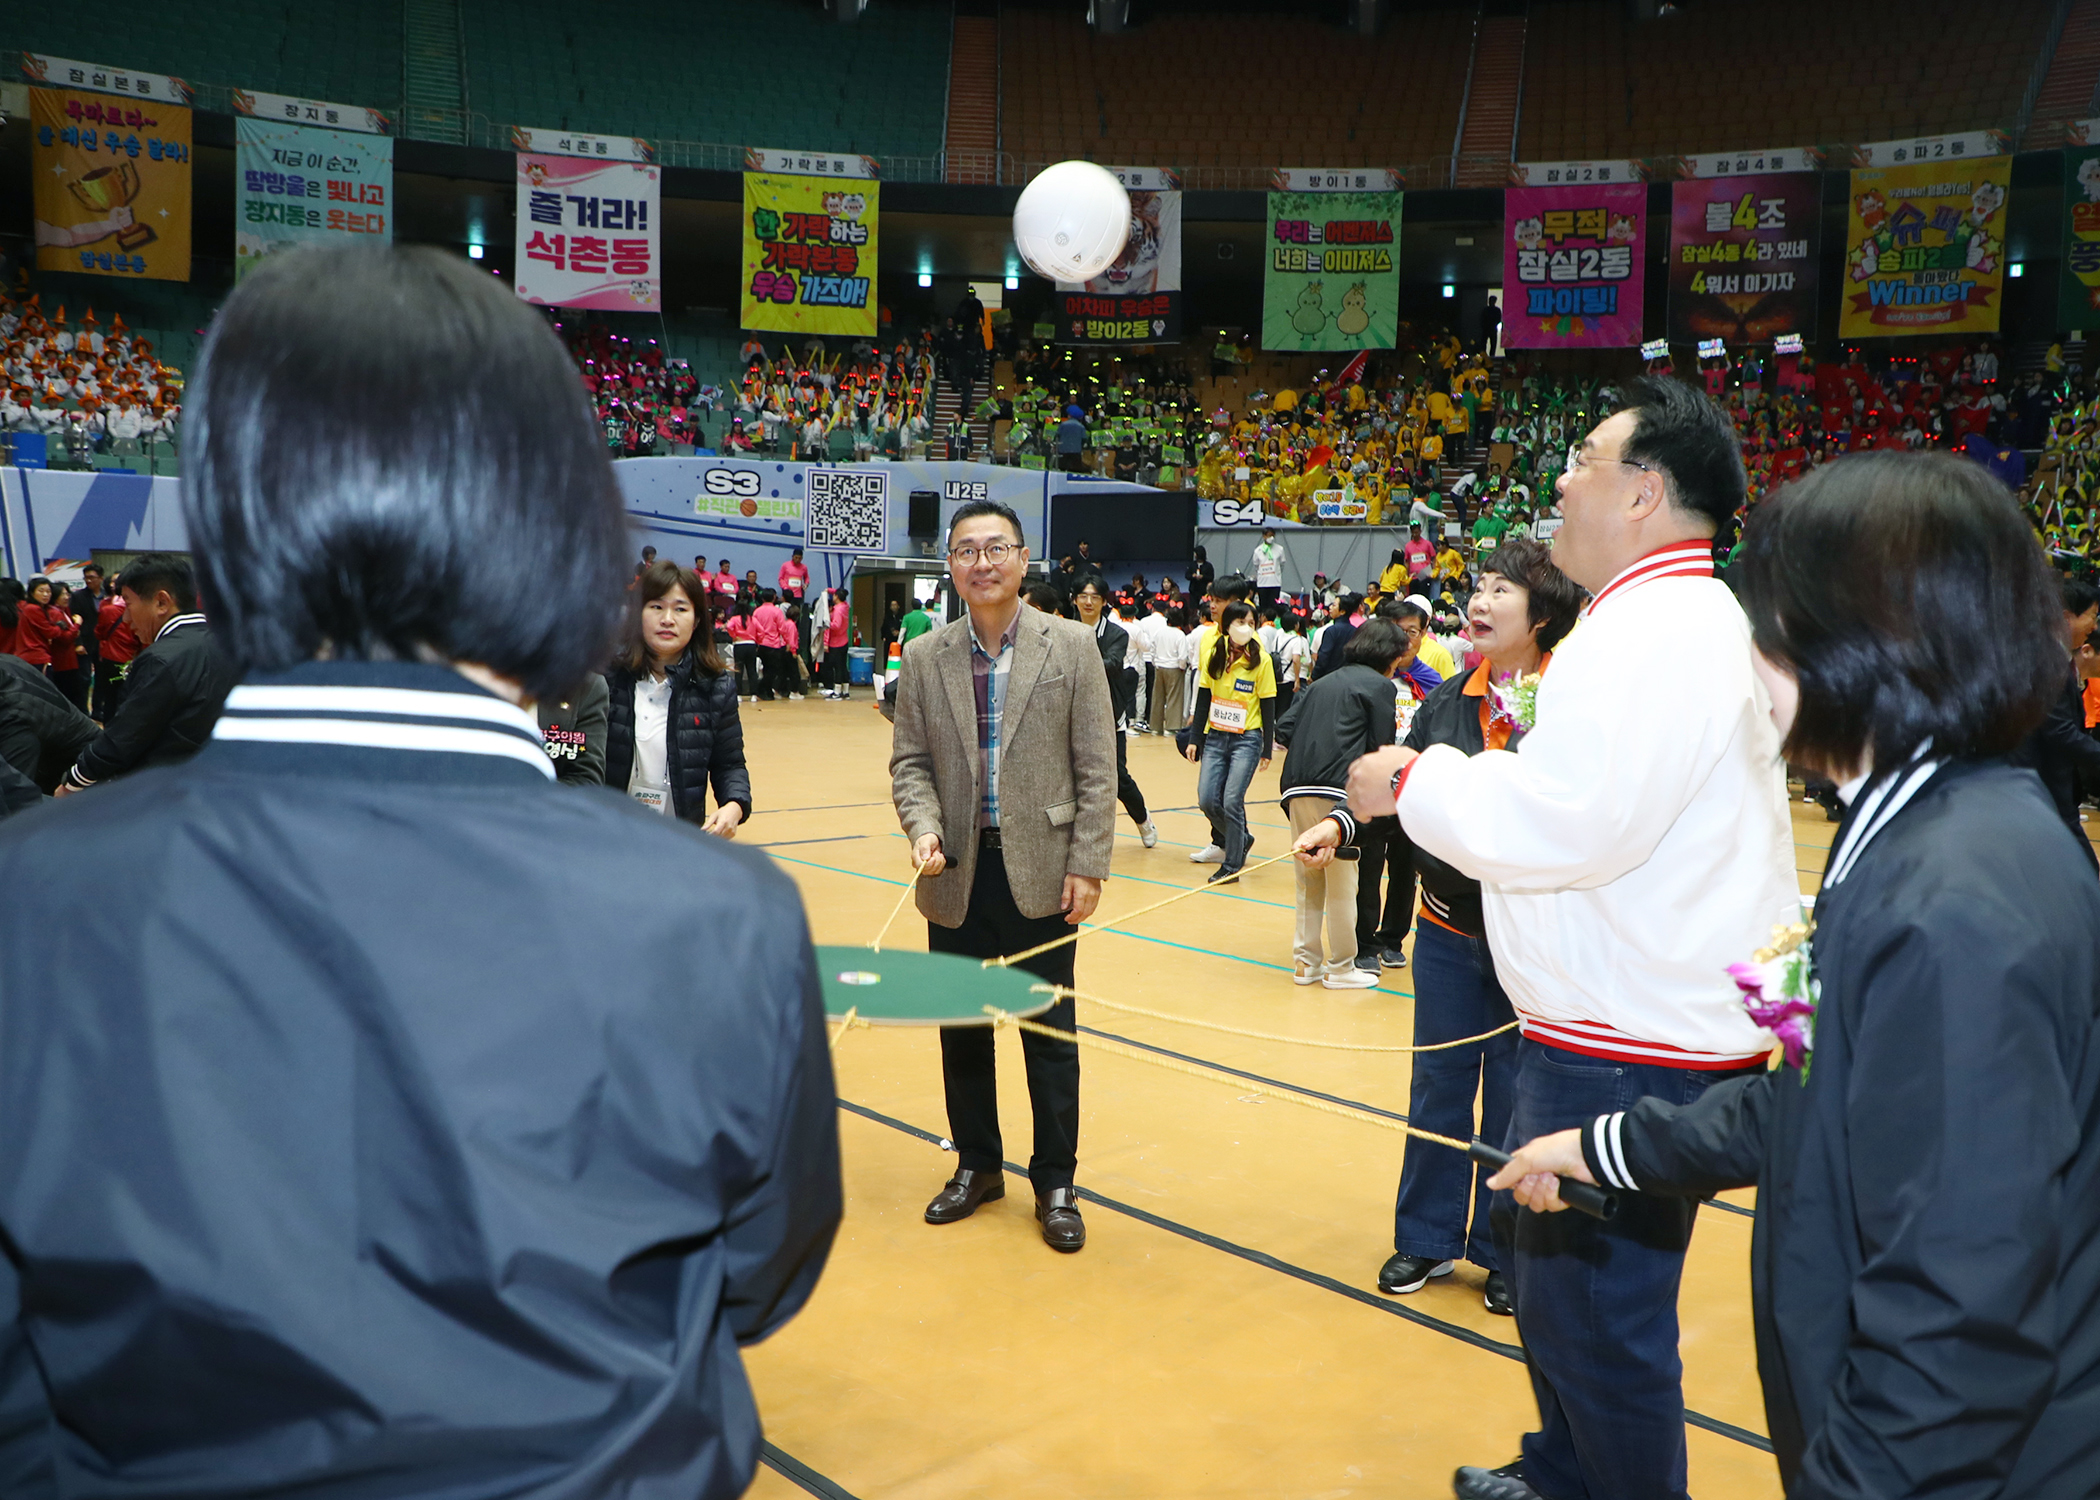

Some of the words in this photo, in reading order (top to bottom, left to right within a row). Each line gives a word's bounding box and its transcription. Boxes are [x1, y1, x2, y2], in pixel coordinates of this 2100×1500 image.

[69, 69, 150, 93] 잠실본동
[285, 104, 339, 123] 장지동
[104, 132, 142, 158] 우승
[558, 139, 608, 155] 석촌동
[1893, 141, 1965, 162] 송파2동
[272, 149, 303, 167] 지금
[307, 154, 323, 168] 이
[327, 156, 361, 175] 순간,
[781, 157, 845, 172] 가락본동
[1717, 157, 1783, 173] 잠실4동
[1309, 175, 1367, 188] 방이1동
[1547, 168, 1611, 182] 잠실2동
[245, 170, 321, 198] 땀방울은
[326, 180, 384, 206] 빛나고
[245, 200, 321, 228] 장지동은
[326, 209, 385, 234] 웃는다
[529, 190, 647, 231] 즐겨라!
[1706, 193, 1785, 232] 불4조
[753, 206, 780, 239] 한
[783, 212, 867, 245] 가락하는
[1275, 220, 1323, 243] 우리는
[1543, 208, 1608, 245] 무적
[80, 251, 147, 273] 잠실본동
[526, 230, 650, 275] 석촌동
[762, 241, 858, 273] 가락본동
[1274, 249, 1322, 272] 너희는
[1324, 249, 1392, 273] 이미져스
[1682, 240, 1740, 263] 잠실4동
[1743, 239, 1774, 261] 4라
[1777, 240, 1808, 260] 있네
[1877, 244, 1968, 273] 송파2동
[1518, 246, 1632, 282] 잠실2동
[751, 271, 797, 304] 우승
[800, 276, 869, 308] 가즈아!
[1690, 270, 1739, 294] 4워서
[1744, 272, 1796, 292] 이기자
[1867, 280, 1976, 306] Winner
[1120, 295, 1170, 317] 우승은
[1526, 286, 1618, 317] 파이팅!
[1086, 320, 1149, 339] 방이2동
[704, 468, 761, 497] S3
[945, 481, 988, 500] 내2문
[697, 497, 740, 514] #직관
[756, 500, 800, 518] 챌린지
[1214, 499, 1264, 525] S4
[1214, 708, 1241, 722] 풍납2동
